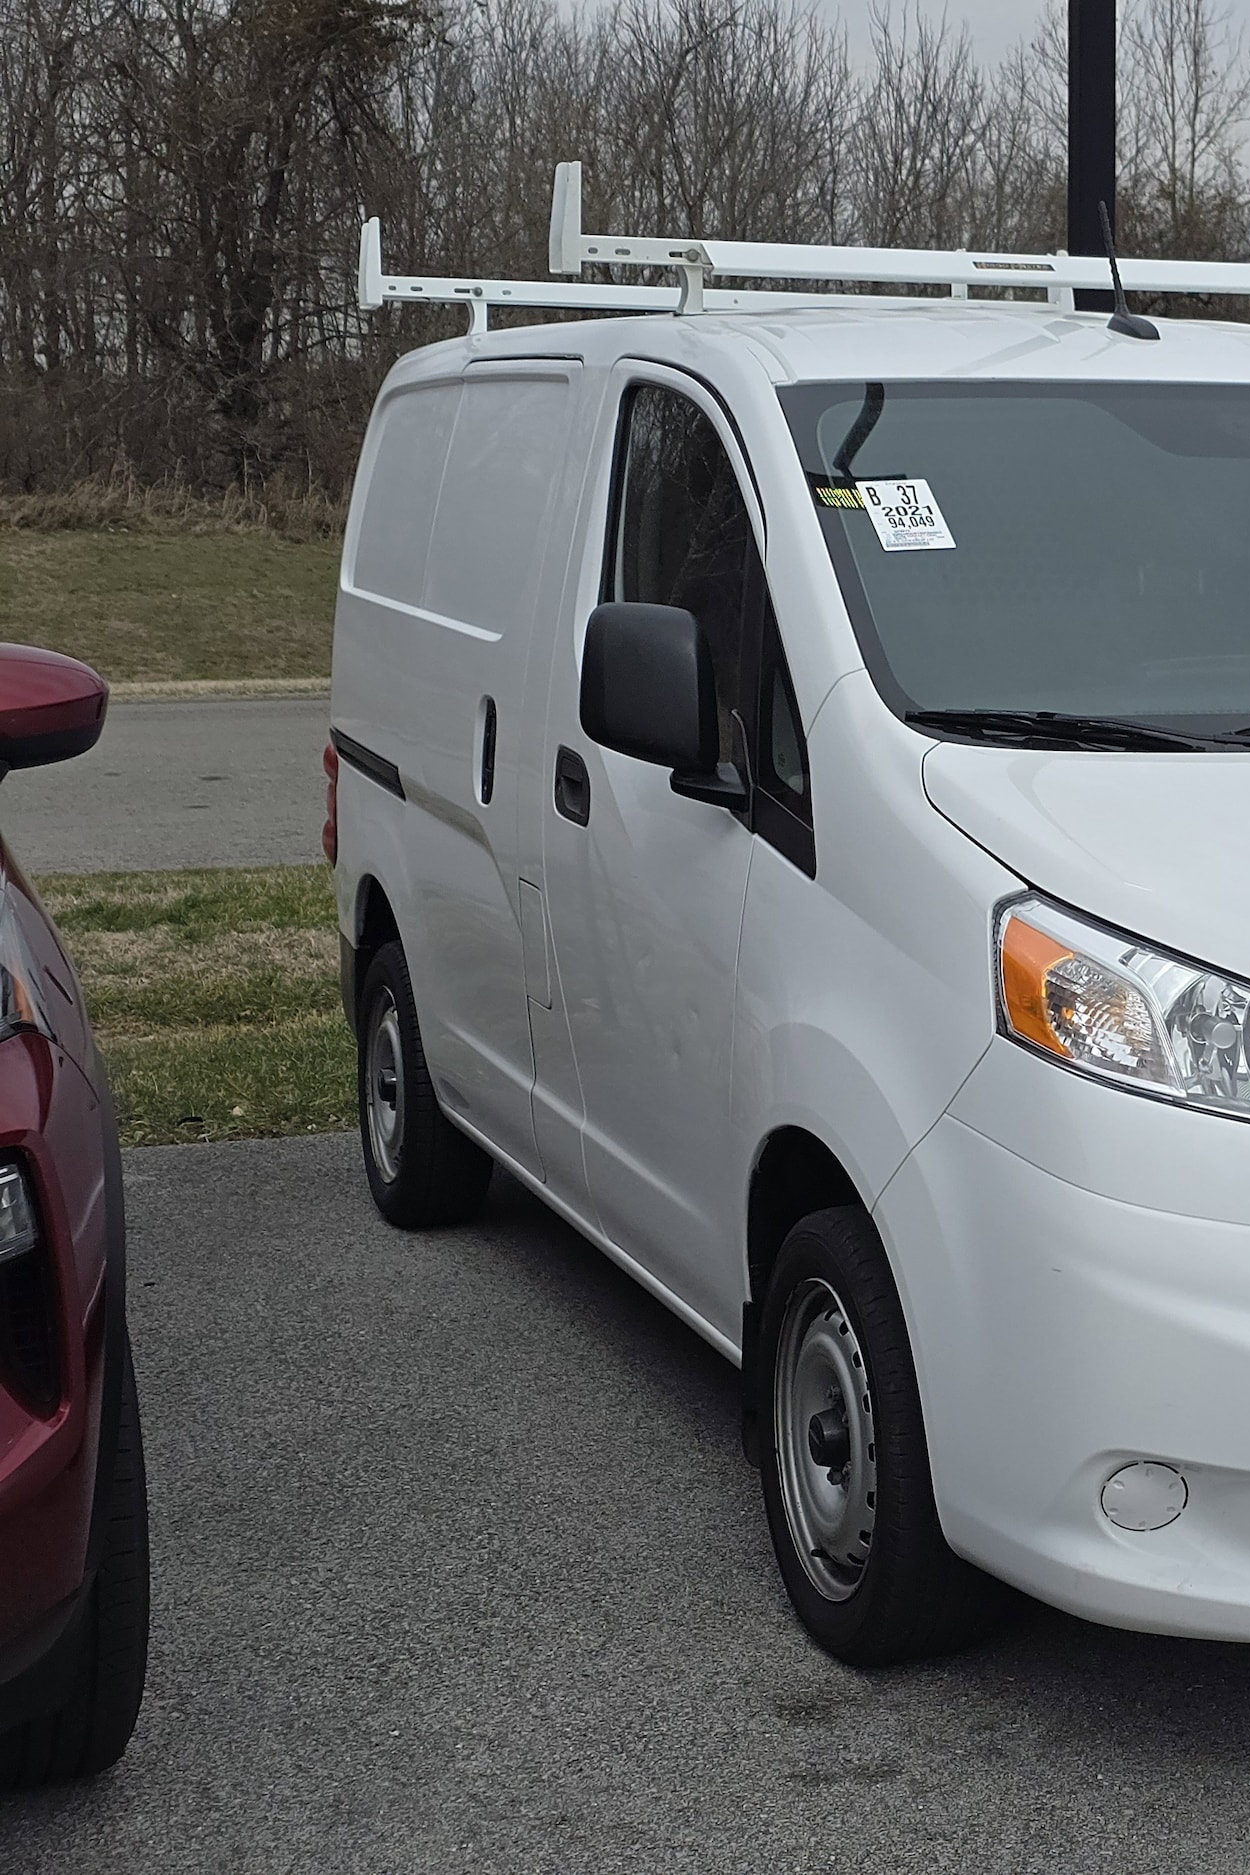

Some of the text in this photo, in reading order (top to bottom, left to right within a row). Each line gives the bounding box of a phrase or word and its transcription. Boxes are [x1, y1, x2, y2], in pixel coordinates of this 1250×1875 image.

[866, 487, 881, 506] B
[897, 485, 919, 505] 37
[882, 505, 934, 517] 2021
[888, 516, 935, 529] 94,049
